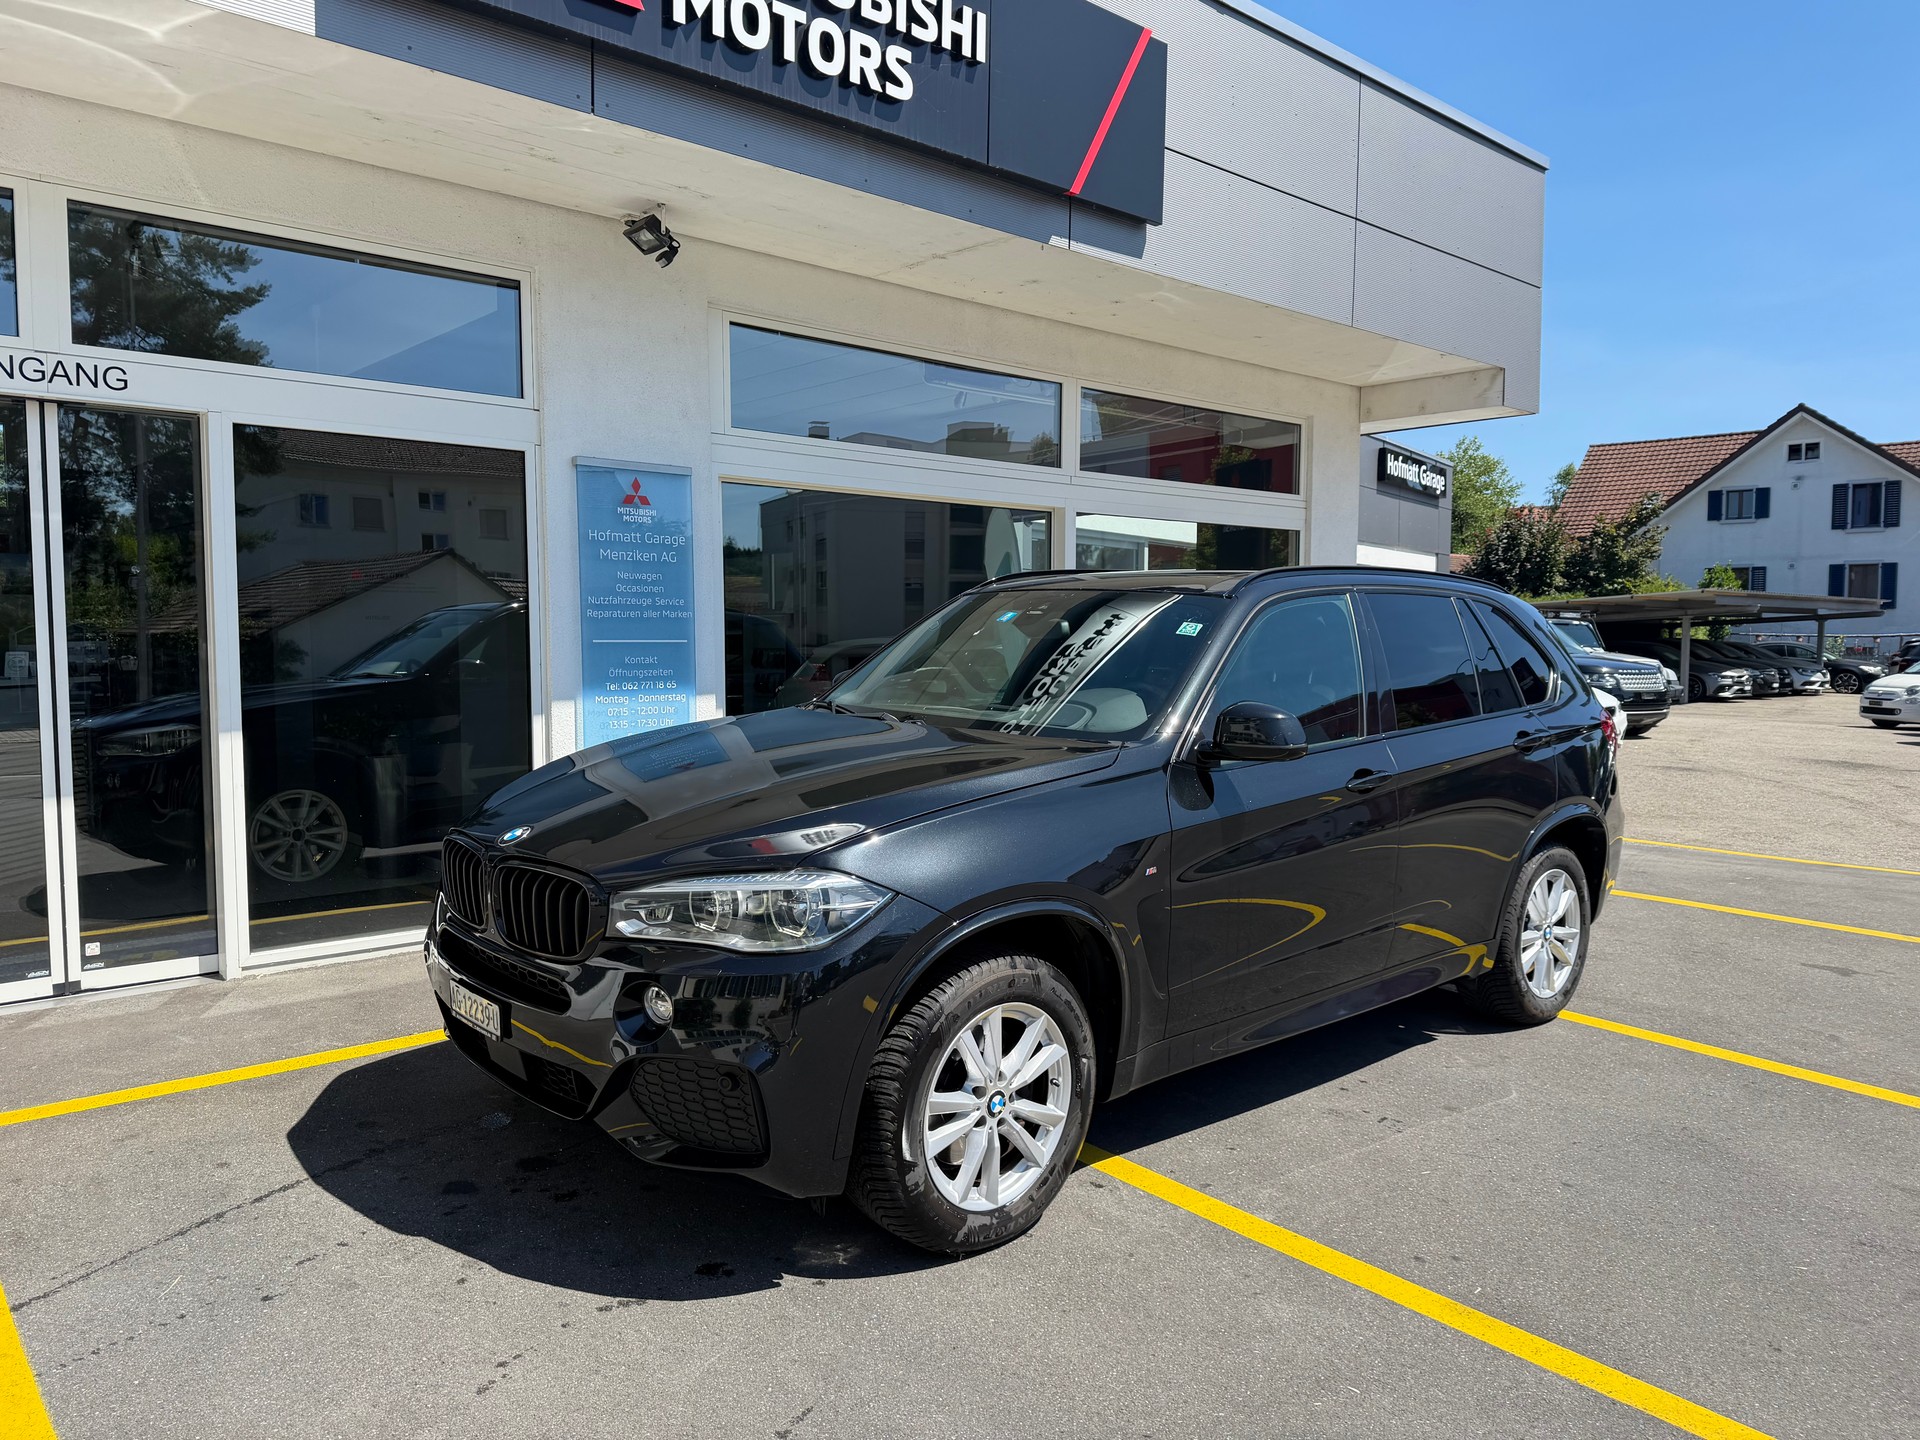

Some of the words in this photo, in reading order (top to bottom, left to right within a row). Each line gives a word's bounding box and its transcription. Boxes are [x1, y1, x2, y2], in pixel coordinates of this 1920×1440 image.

[1387, 453, 1419, 483] Hofmatt
[1420, 465, 1445, 494] Garage
[617, 507, 657, 516] MITSUBISHI
[623, 515, 652, 524] MOTORS
[588, 529, 641, 543] Hofmatt
[644, 532, 686, 547] Garage
[599, 548, 657, 562] Menziken
[660, 551, 677, 563] AG
[617, 571, 663, 582] Neuwagen
[615, 584, 664, 593] Occasionen
[588, 596, 652, 607] Nutzfahrzeuge
[655, 597, 685, 606] Service
[586, 609, 641, 619] Reparaturen
[643, 610, 661, 618] aller
[662, 610, 693, 618] Marken
[624, 656, 658, 664] Kontakt
[608, 667, 674, 679] Öffnungszeiten
[622, 681, 639, 690] 062
[640, 681, 654, 689] 771
[655, 681, 665, 689] 18
[666, 680, 677, 689] 65
[595, 695, 629, 704] Montag
[638, 693, 686, 702] Donnerstag
[607, 707, 629, 717] 07:15
[637, 706, 659, 716] 12:00
[660, 705, 675, 714] Uhr
[609, 720, 629, 729] 13:15
[637, 719, 658, 728] 17:30
[660, 718, 674, 726] Uhr
